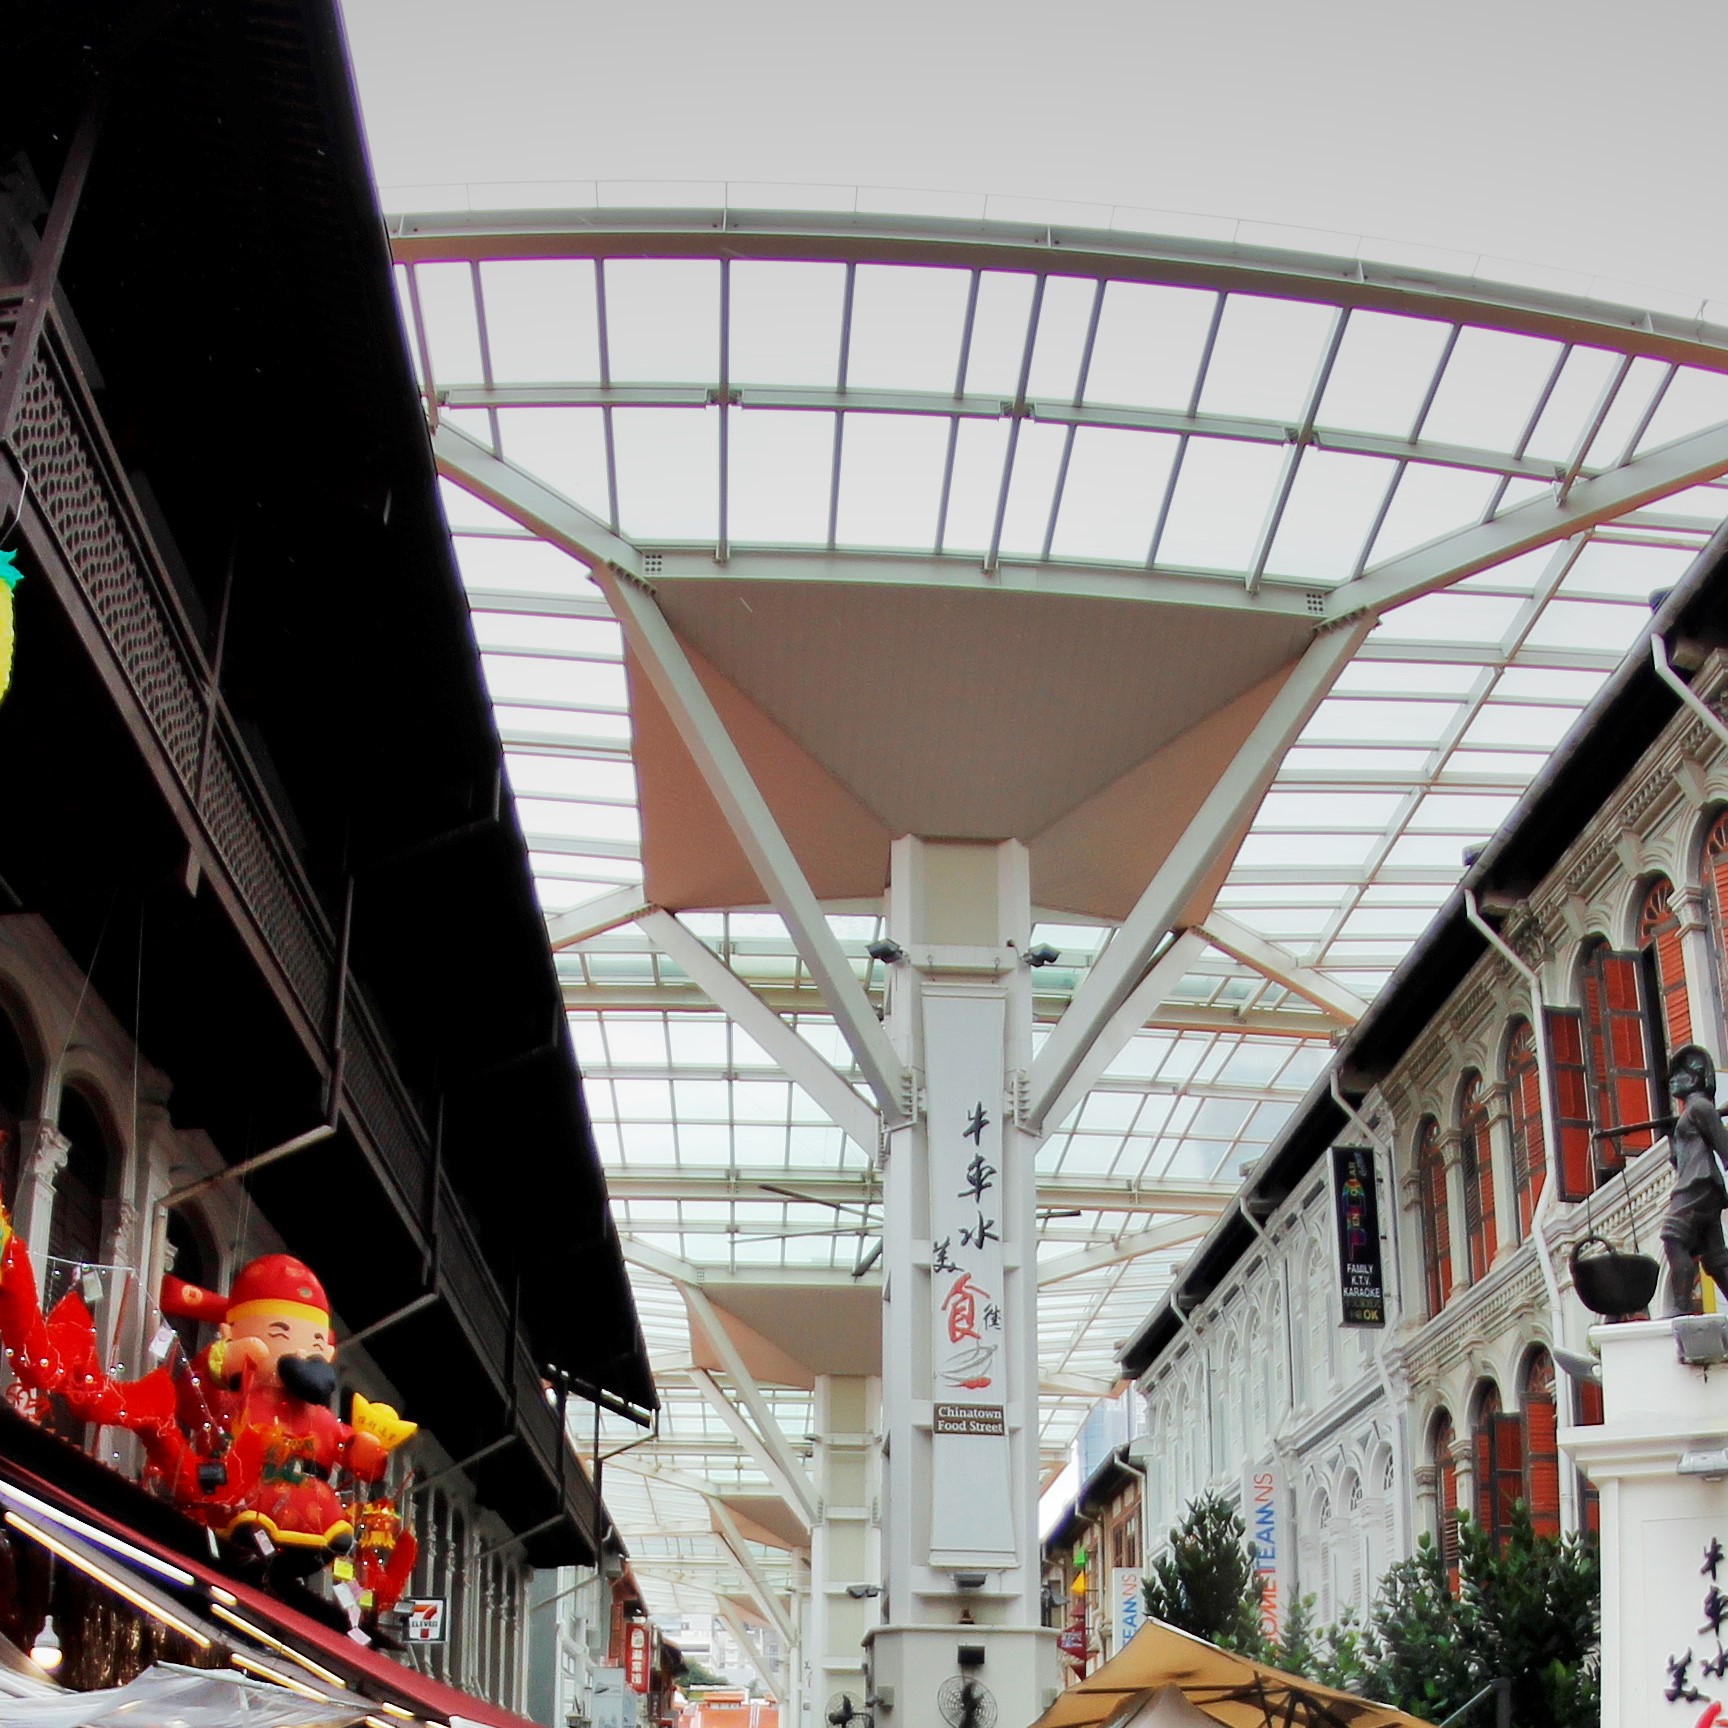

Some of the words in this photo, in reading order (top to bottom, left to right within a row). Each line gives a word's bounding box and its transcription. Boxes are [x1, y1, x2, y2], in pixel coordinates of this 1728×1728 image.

[1347, 1263, 1374, 1274] FAMILY
[1343, 1286, 1381, 1298] KARAOKE
[938, 1406, 1002, 1419] Chinatown
[938, 1420, 967, 1432] Food
[969, 1421, 1003, 1433] Street
[413, 1604, 437, 1638] 7
